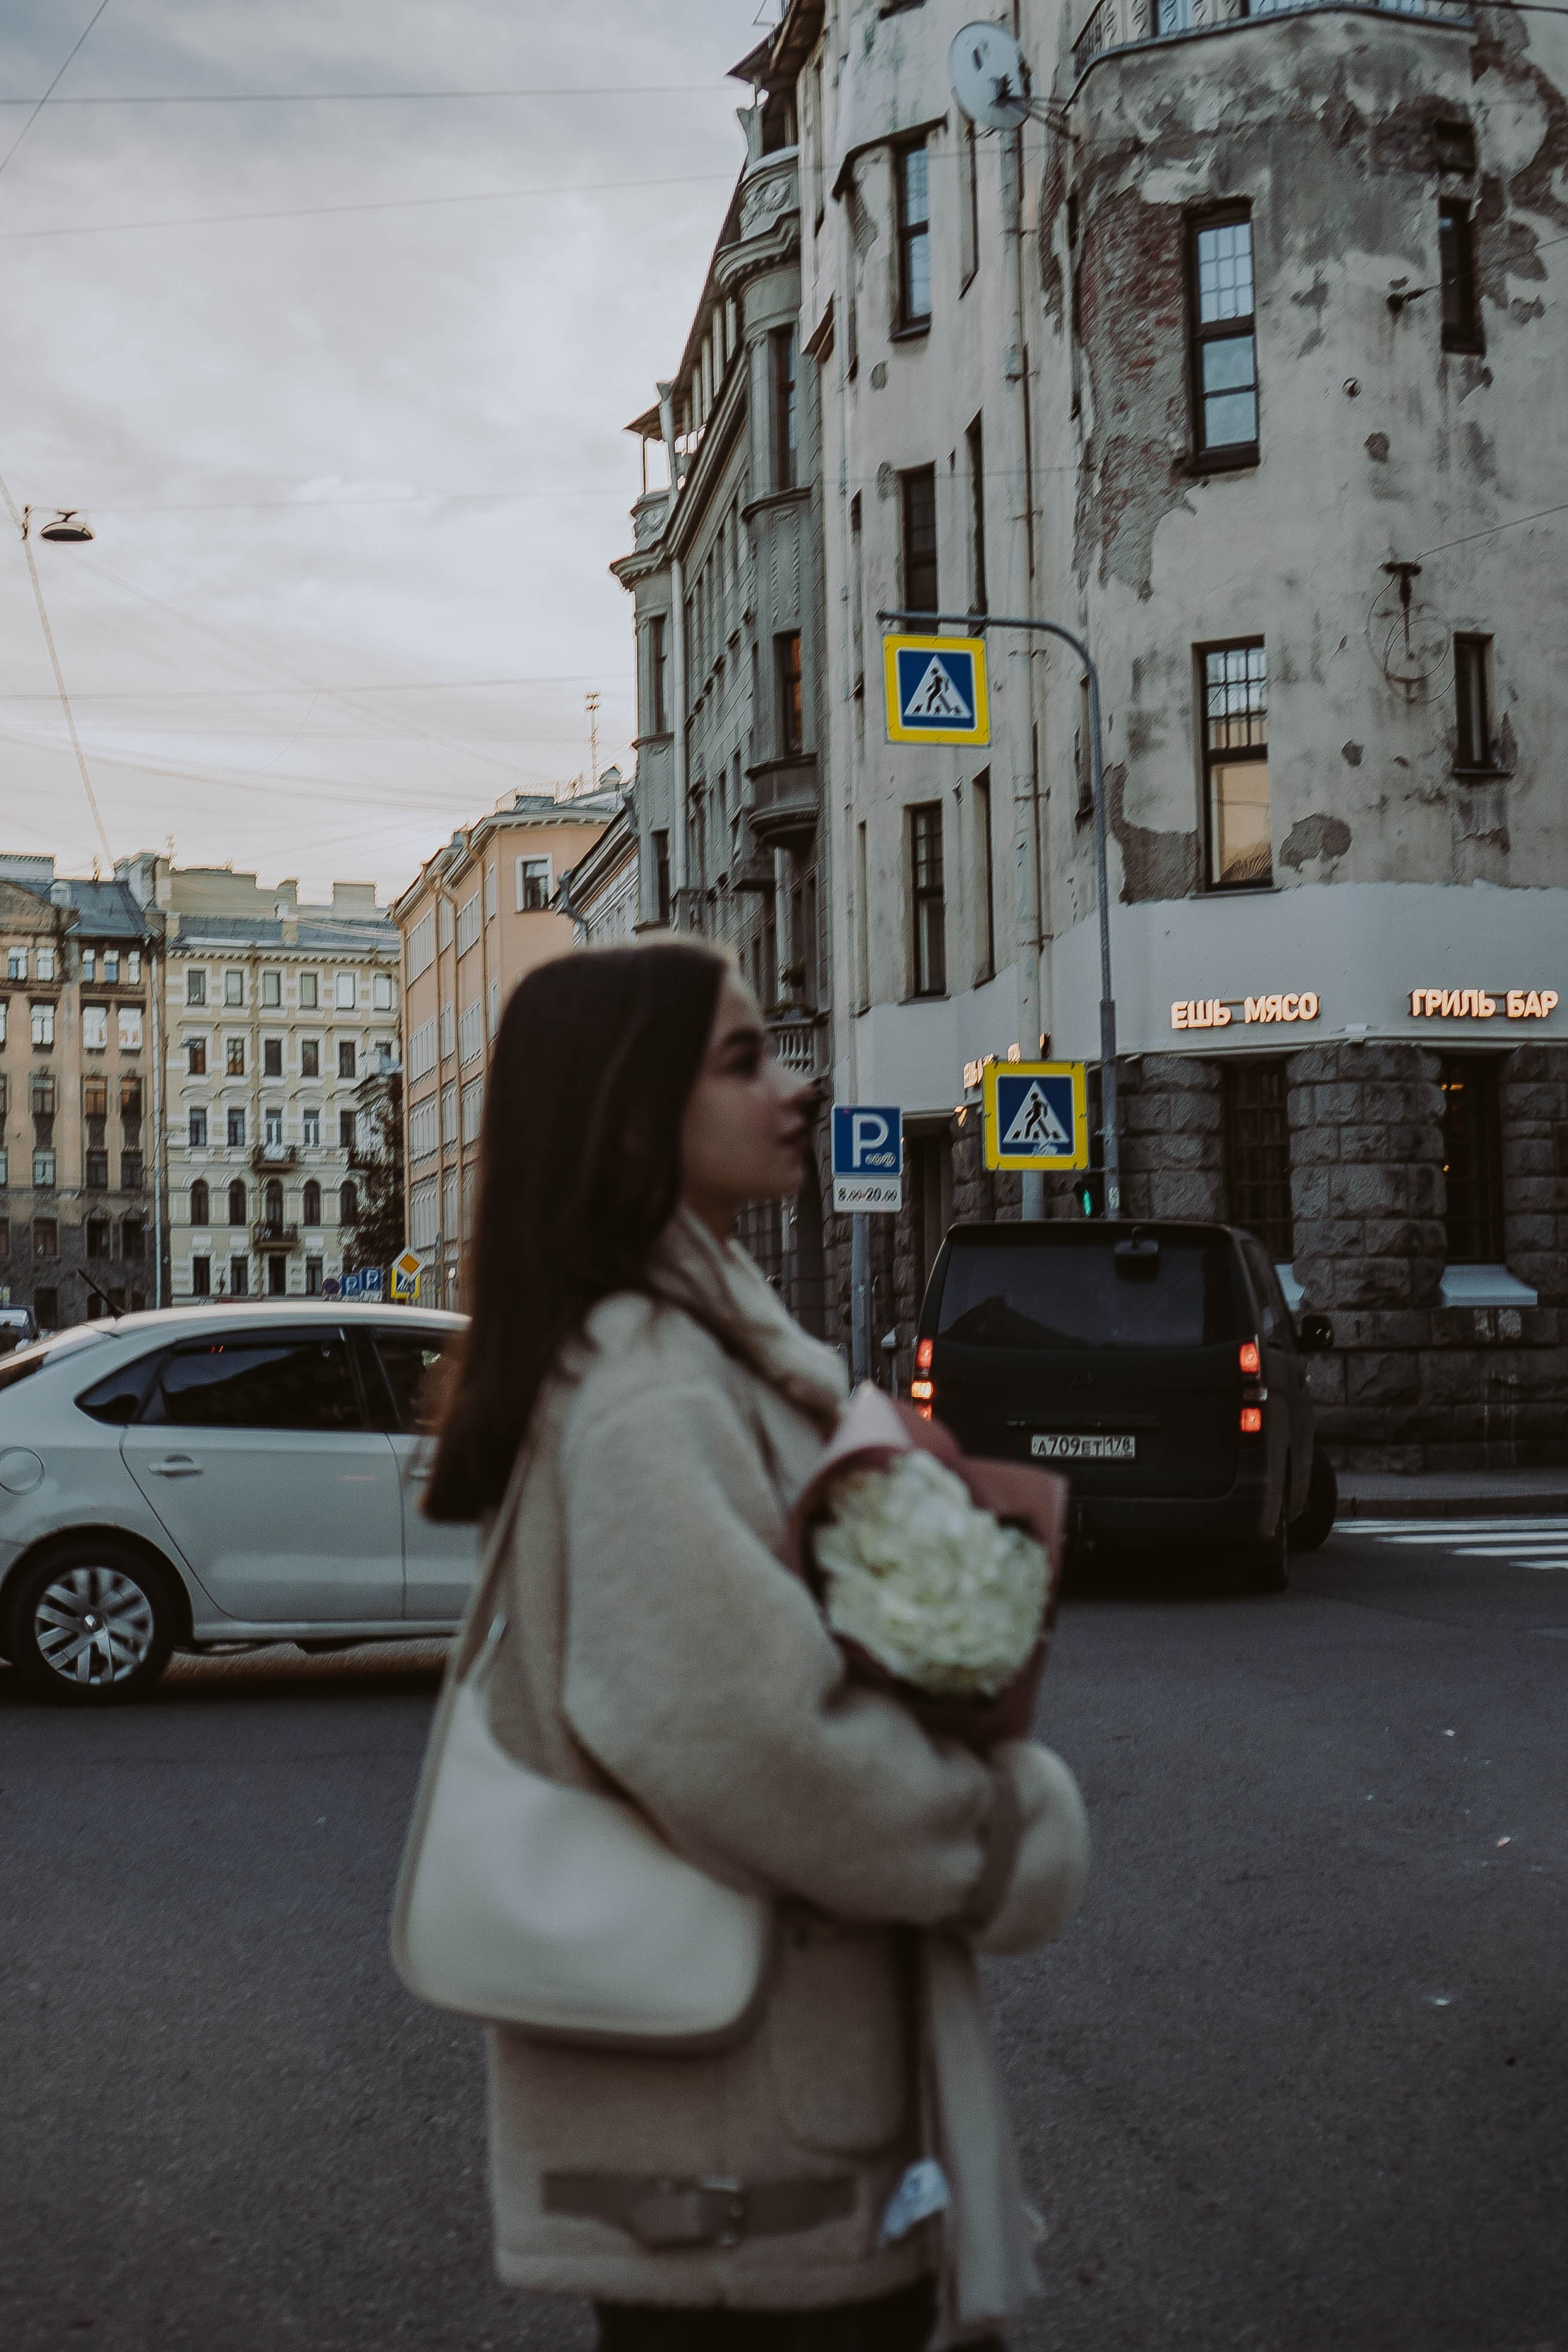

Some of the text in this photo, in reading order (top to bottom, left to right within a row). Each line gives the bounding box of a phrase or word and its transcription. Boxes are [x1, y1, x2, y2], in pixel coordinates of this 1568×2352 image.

[1170, 991, 1318, 1029] ЕШЬ МЯСО
[1412, 988, 1559, 1018] ГРИЛЬ БАР
[852, 1112, 889, 1169] P
